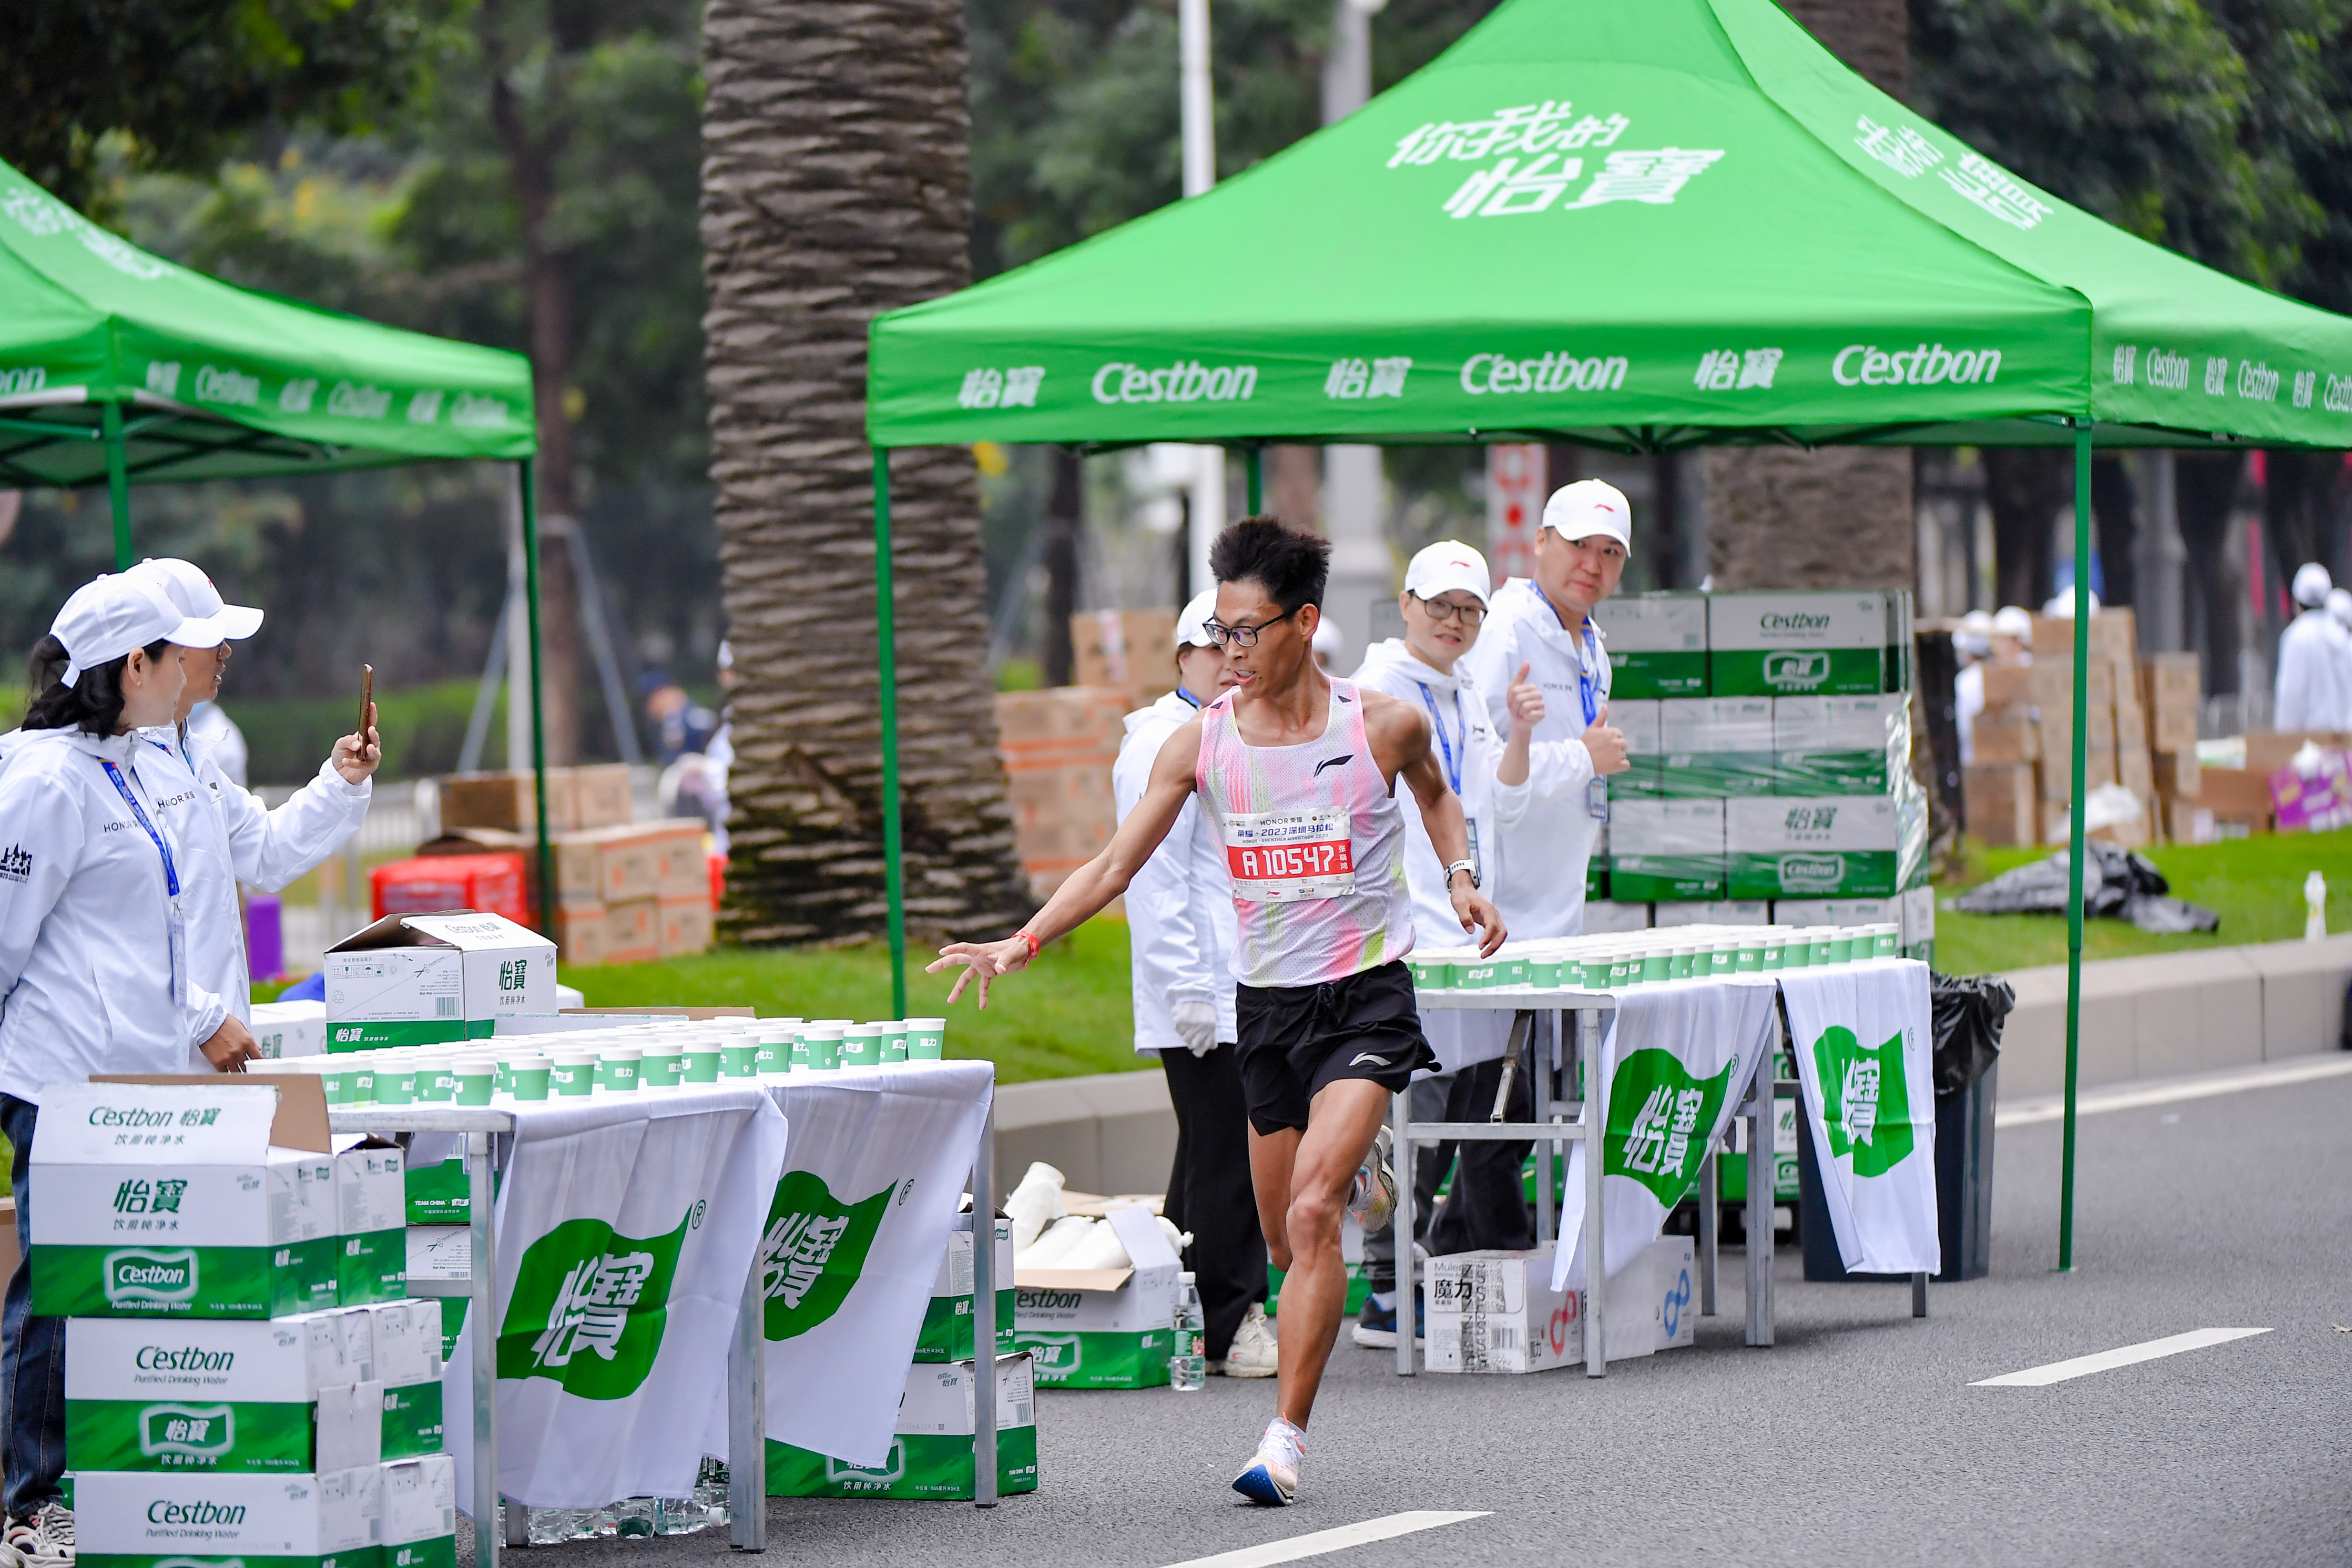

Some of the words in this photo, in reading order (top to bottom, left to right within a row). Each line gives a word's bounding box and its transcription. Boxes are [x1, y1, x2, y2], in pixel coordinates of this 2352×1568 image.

[1386, 100, 1631, 168] 你我的
[1442, 147, 1725, 219] 怡寶
[1323, 357, 1412, 399] 怡寶
[1694, 348, 1783, 390] 怡寶
[958, 365, 1045, 409] 怡寶
[499, 959, 527, 991] 怡寶
[335, 1027, 363, 1042] 怡寶
[920, 1037, 936, 1047] 魔力
[615, 1067, 633, 1077] 魔力
[1623, 1084, 1704, 1178] 怡寶
[114, 1179, 188, 1213] 怡寶
[1434, 1278, 1472, 1300] 魔力
[531, 1251, 654, 1369] 怡寶
[955, 1300, 969, 1315] 怡寶
[843, 1481, 891, 1491] 饮用纯净水
